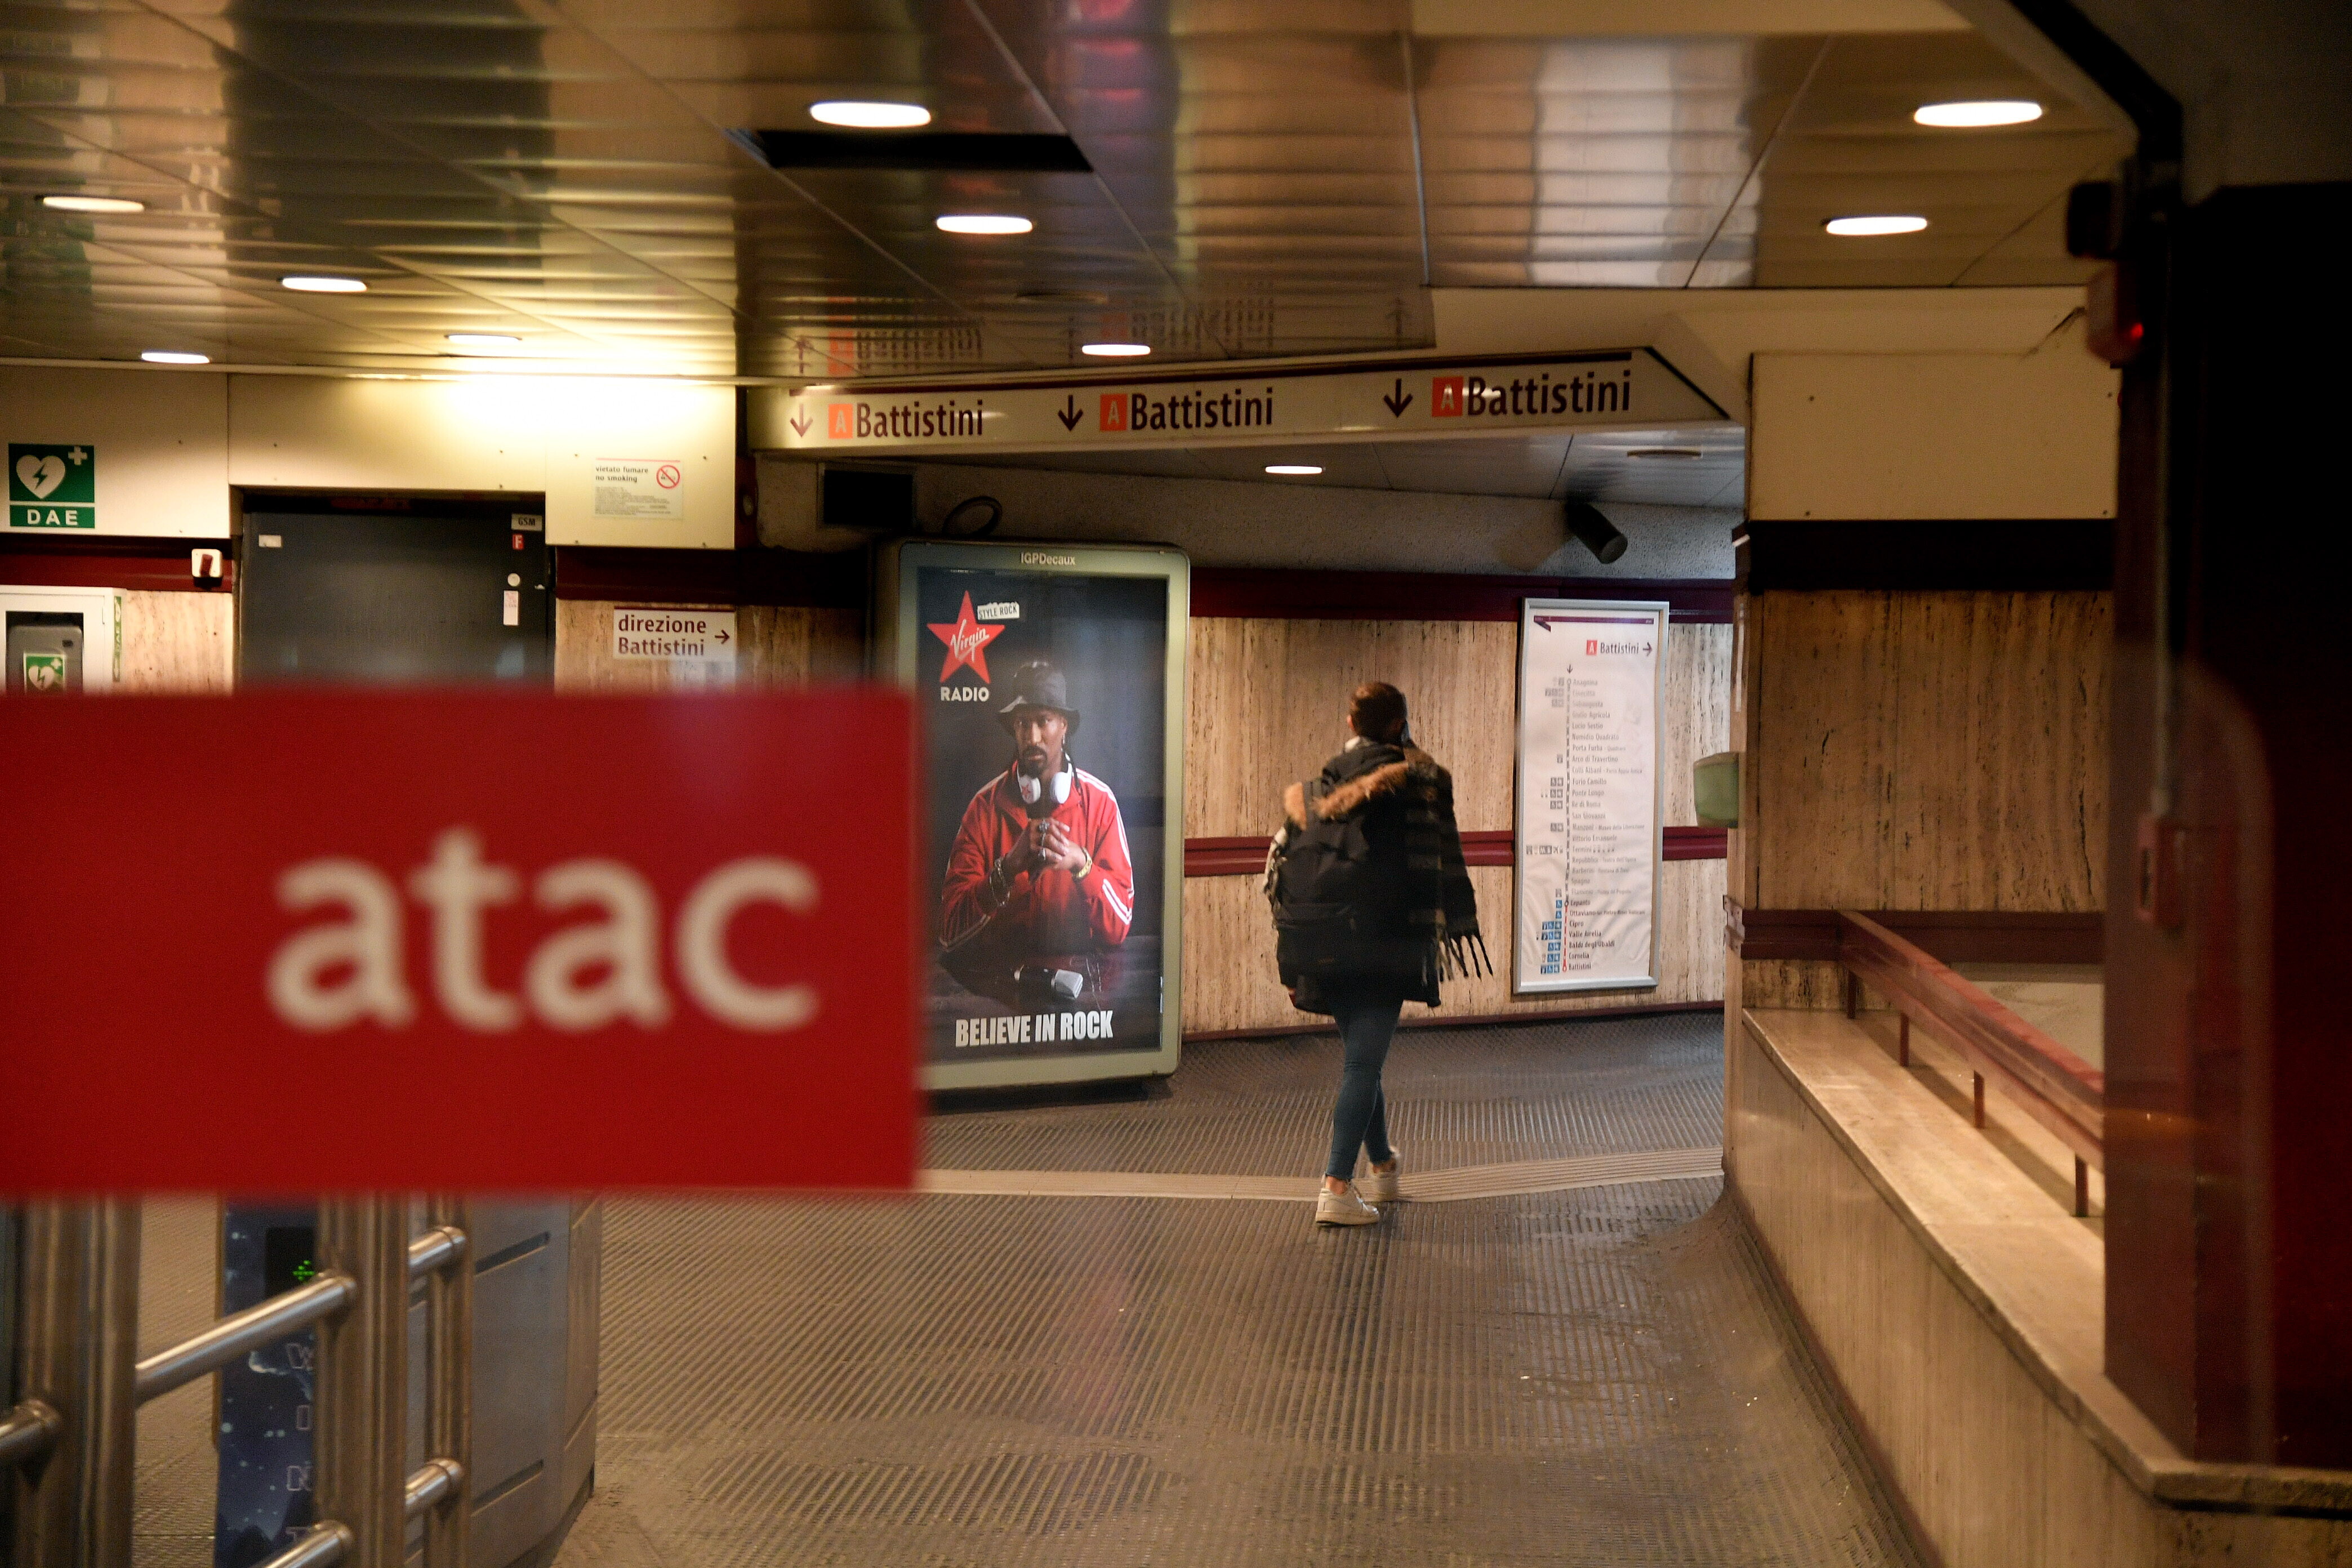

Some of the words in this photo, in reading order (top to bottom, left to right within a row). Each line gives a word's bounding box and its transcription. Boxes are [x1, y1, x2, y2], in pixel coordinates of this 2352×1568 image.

[1467, 370, 1631, 416] Battistini
[1130, 386, 1273, 431] Battistini
[856, 398, 984, 439] Battistini
[607, 475, 638, 483] smoking
[27, 509, 78, 526] DAE
[518, 518, 536, 526] GSM
[1020, 552, 1076, 566] IGPDecaux
[978, 606, 997, 619] STYLE
[999, 604, 1018, 617] ROCK
[618, 614, 706, 633] direzione
[618, 637, 705, 656] Battistini
[950, 619, 990, 662] Virgin
[1600, 642, 1639, 654] Battistini
[939, 687, 990, 702] RADIO
[266, 826, 820, 1032] atac
[955, 1015, 1031, 1048] BELIEVE
[1035, 1013, 1055, 1043] IN
[1060, 1010, 1114, 1041] ROCK
